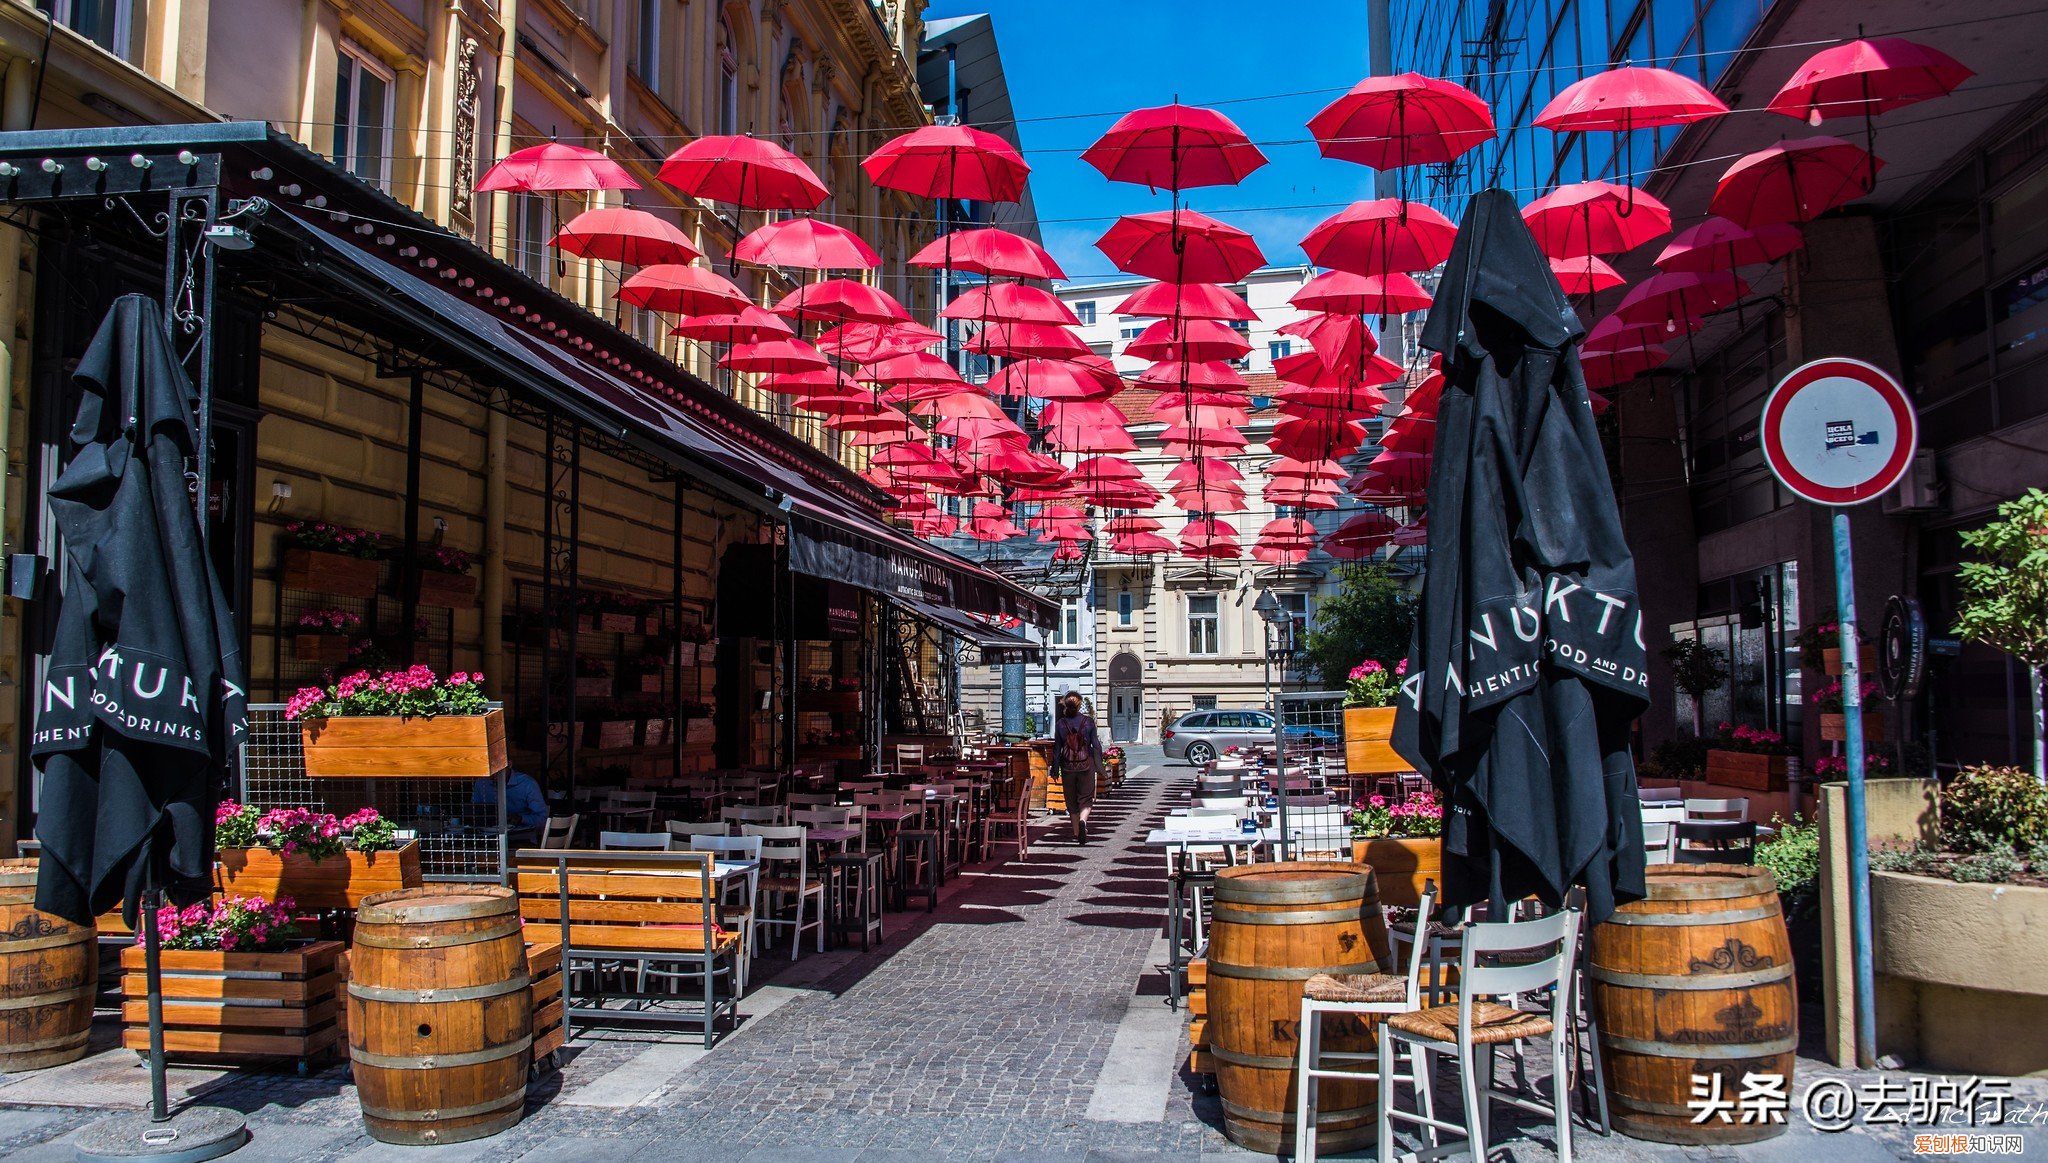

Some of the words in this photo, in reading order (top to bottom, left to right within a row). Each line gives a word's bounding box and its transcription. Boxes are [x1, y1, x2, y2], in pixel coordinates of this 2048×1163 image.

[890, 552, 948, 588] MANUFAKTURA
[1593, 657, 1617, 673] AND
[126, 714, 202, 741] DRINKS
